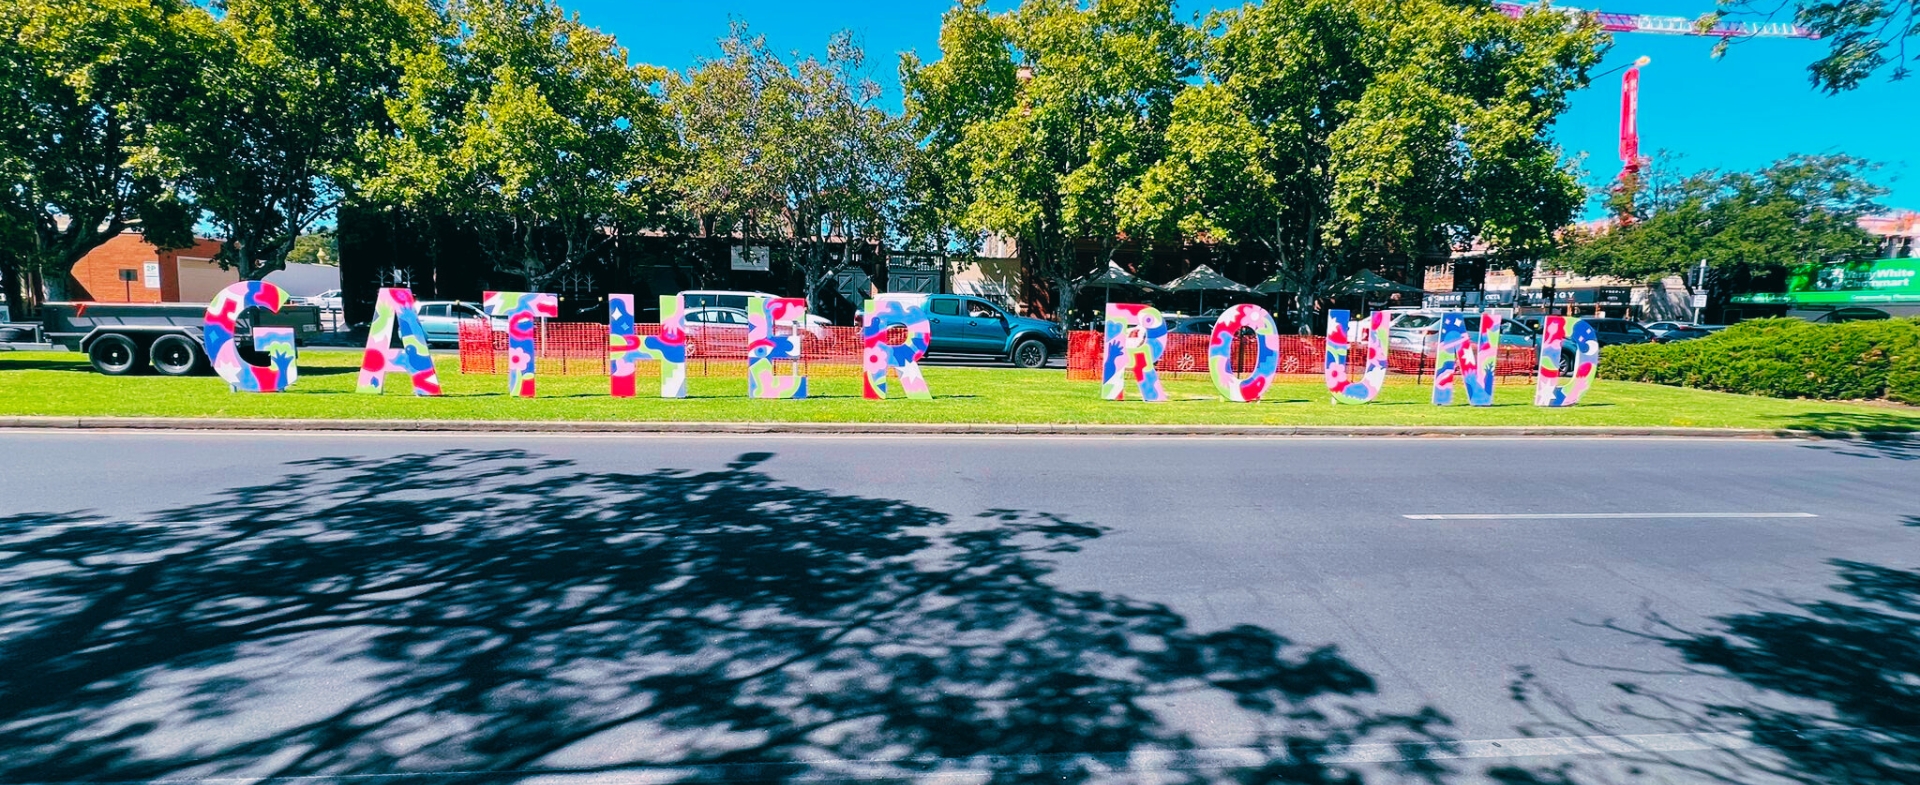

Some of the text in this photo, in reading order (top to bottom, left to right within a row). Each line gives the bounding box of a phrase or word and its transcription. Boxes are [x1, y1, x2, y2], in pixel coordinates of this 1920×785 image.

[1521, 291, 1575, 300] YNRGY
[203, 280, 1597, 405] GATHER ROUND
